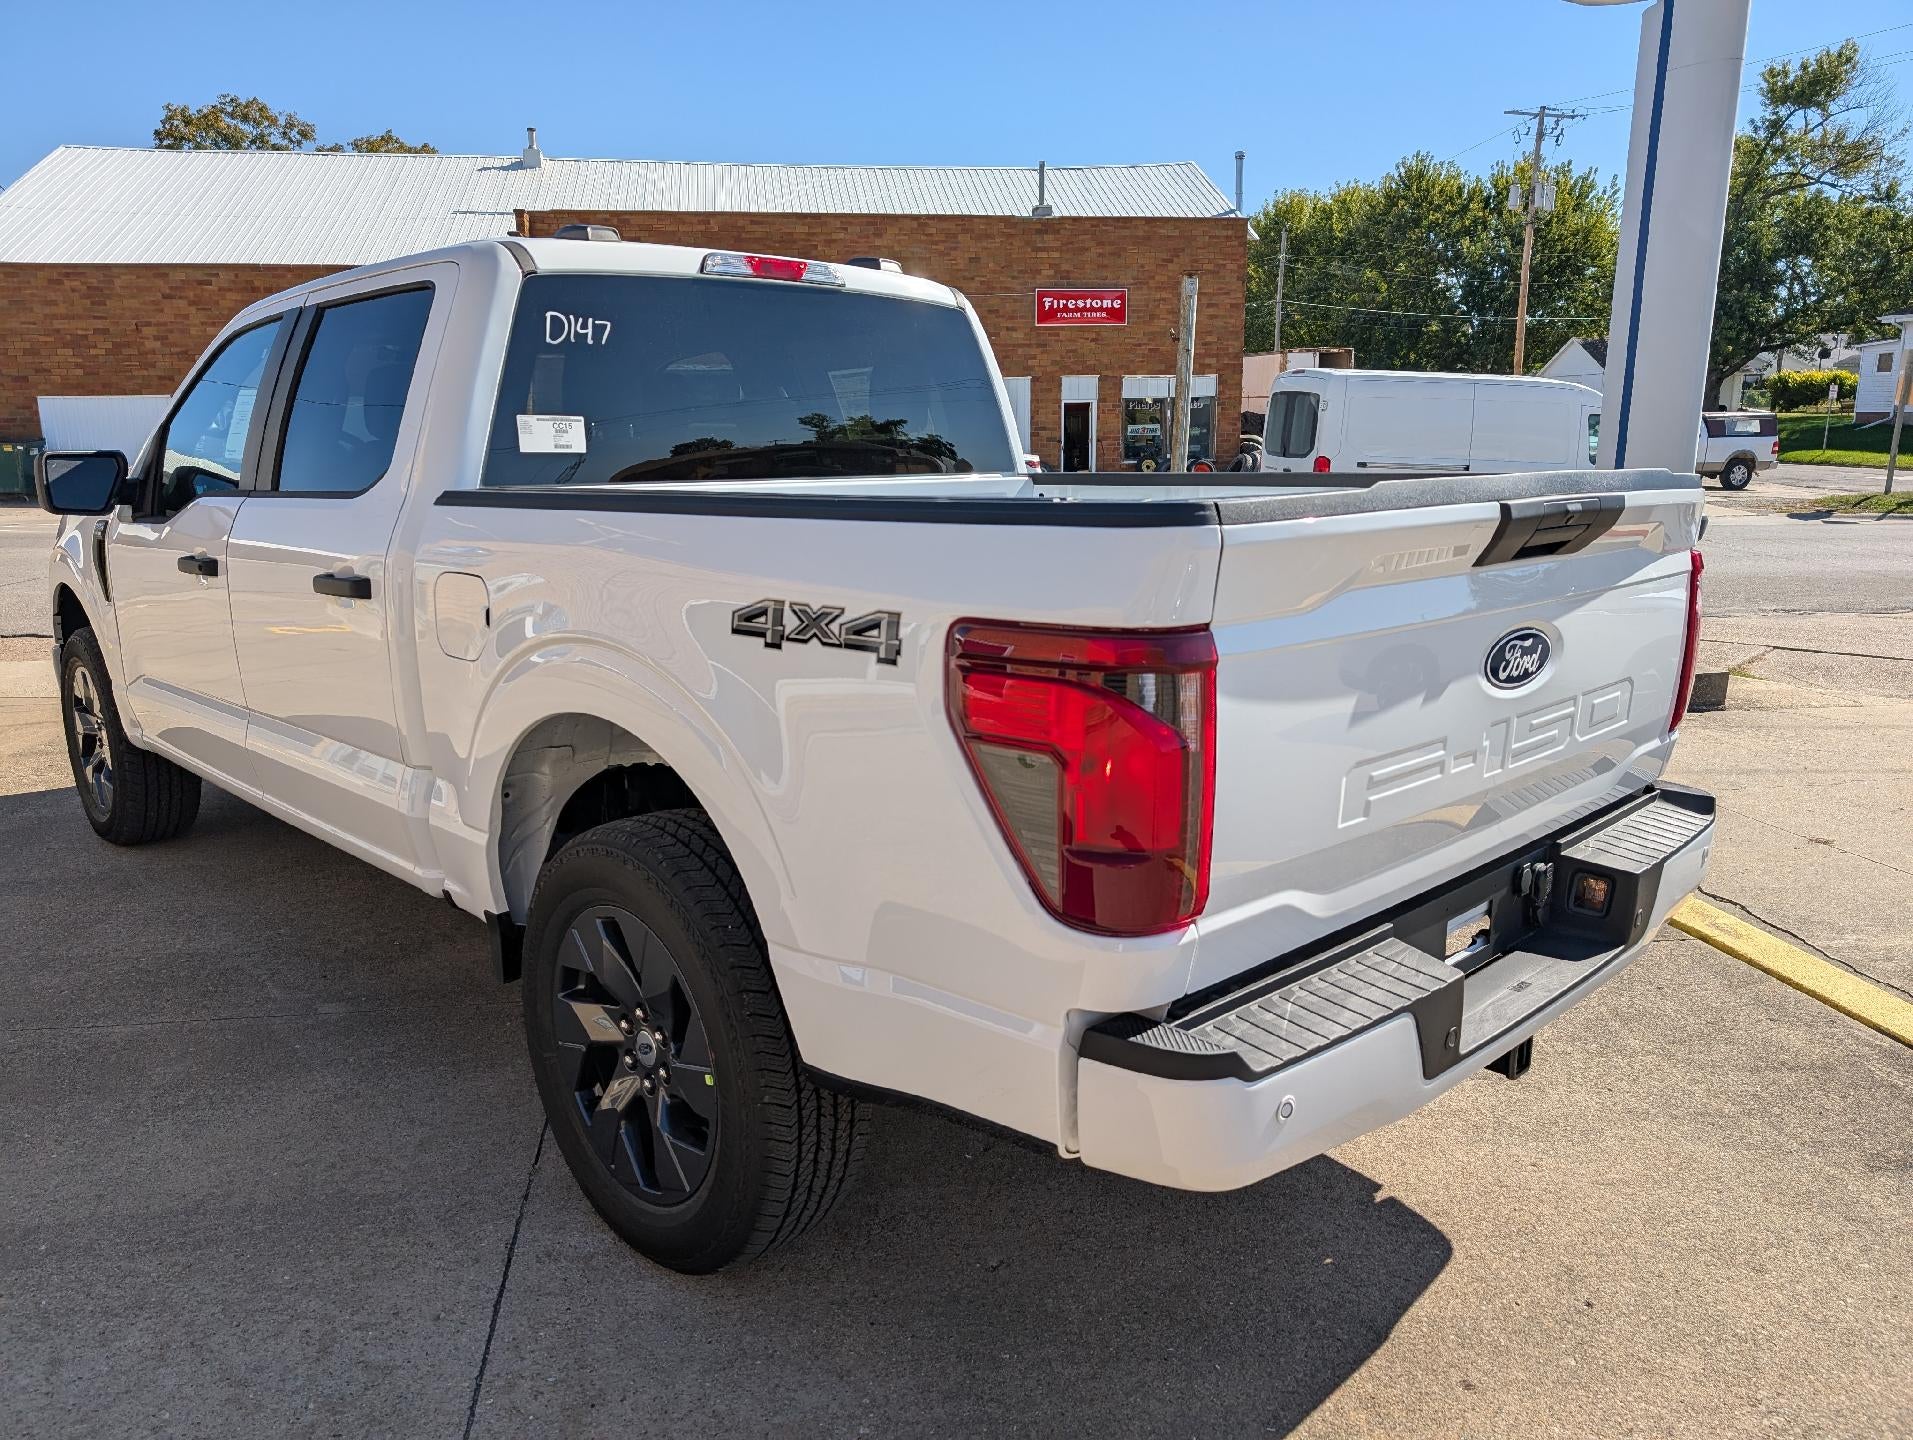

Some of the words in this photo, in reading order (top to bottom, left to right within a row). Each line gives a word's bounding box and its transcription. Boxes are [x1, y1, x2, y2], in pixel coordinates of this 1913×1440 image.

[1043, 297, 1121, 310] Firestone
[545, 311, 611, 344] D147
[552, 422, 573, 430] CC15
[1499, 638, 1542, 680] Ford
[1337, 676, 1635, 829] F-150
